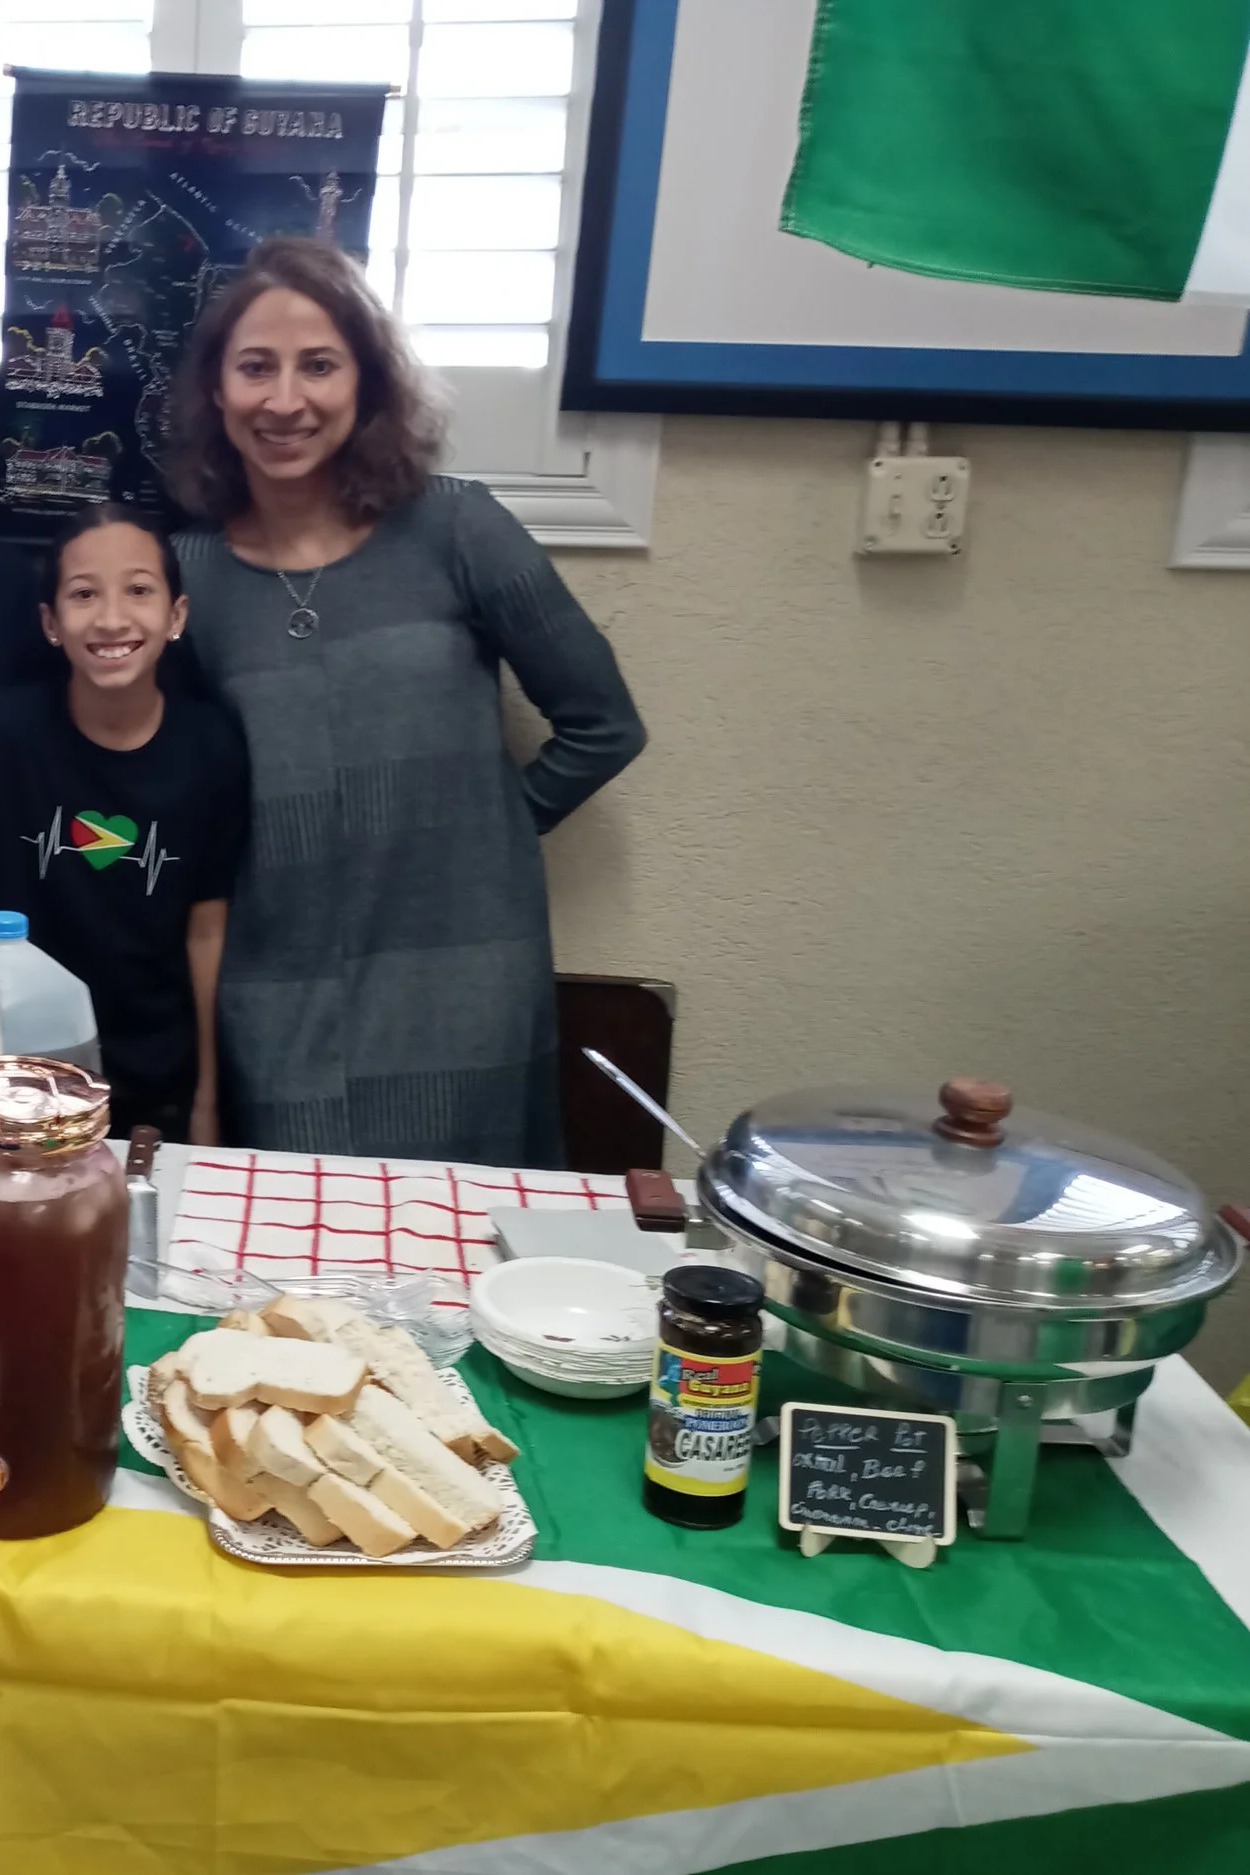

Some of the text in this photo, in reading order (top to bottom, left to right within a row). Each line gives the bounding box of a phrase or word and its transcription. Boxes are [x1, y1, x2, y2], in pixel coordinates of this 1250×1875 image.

[68, 100, 344, 140] REPUBLIC OF GUYANA
